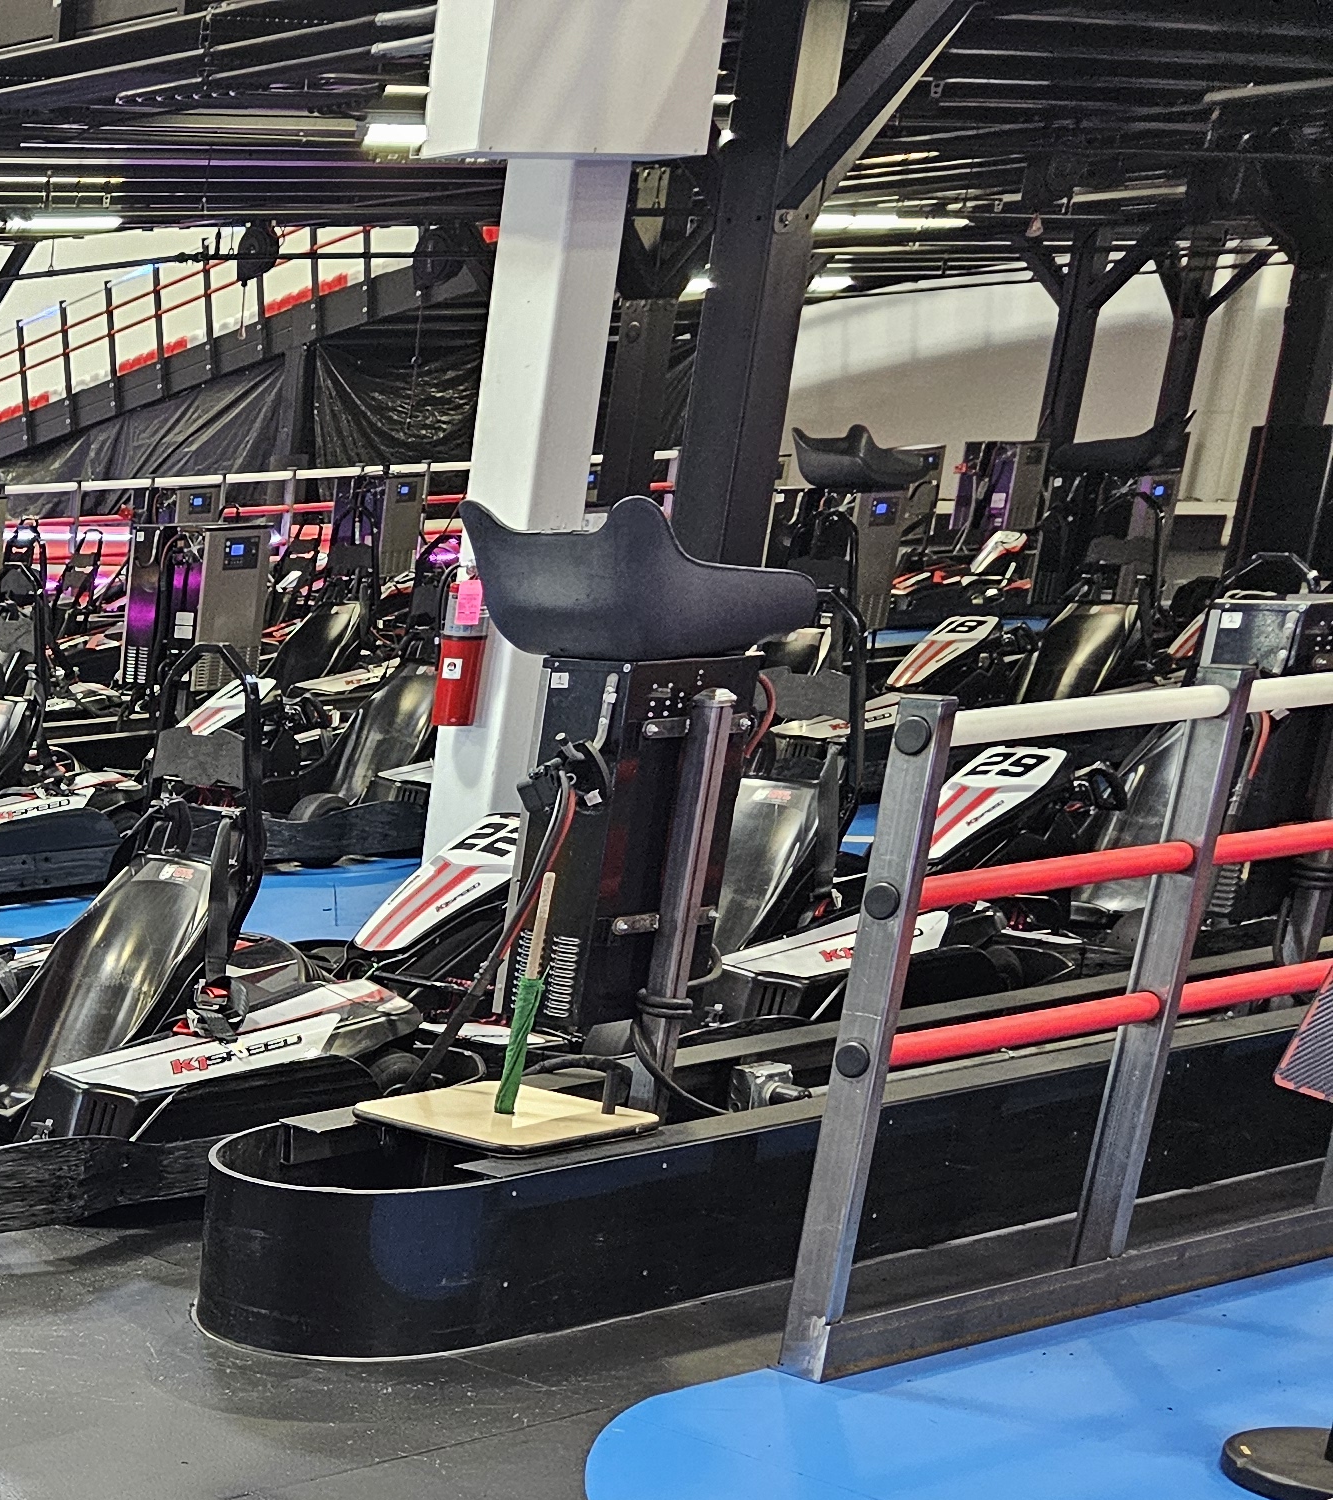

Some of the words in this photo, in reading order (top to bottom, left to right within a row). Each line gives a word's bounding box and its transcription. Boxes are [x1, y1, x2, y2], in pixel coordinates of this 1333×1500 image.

[933, 619, 989, 636] 18
[961, 752, 1053, 778] 29
[447, 822, 519, 858] 22
